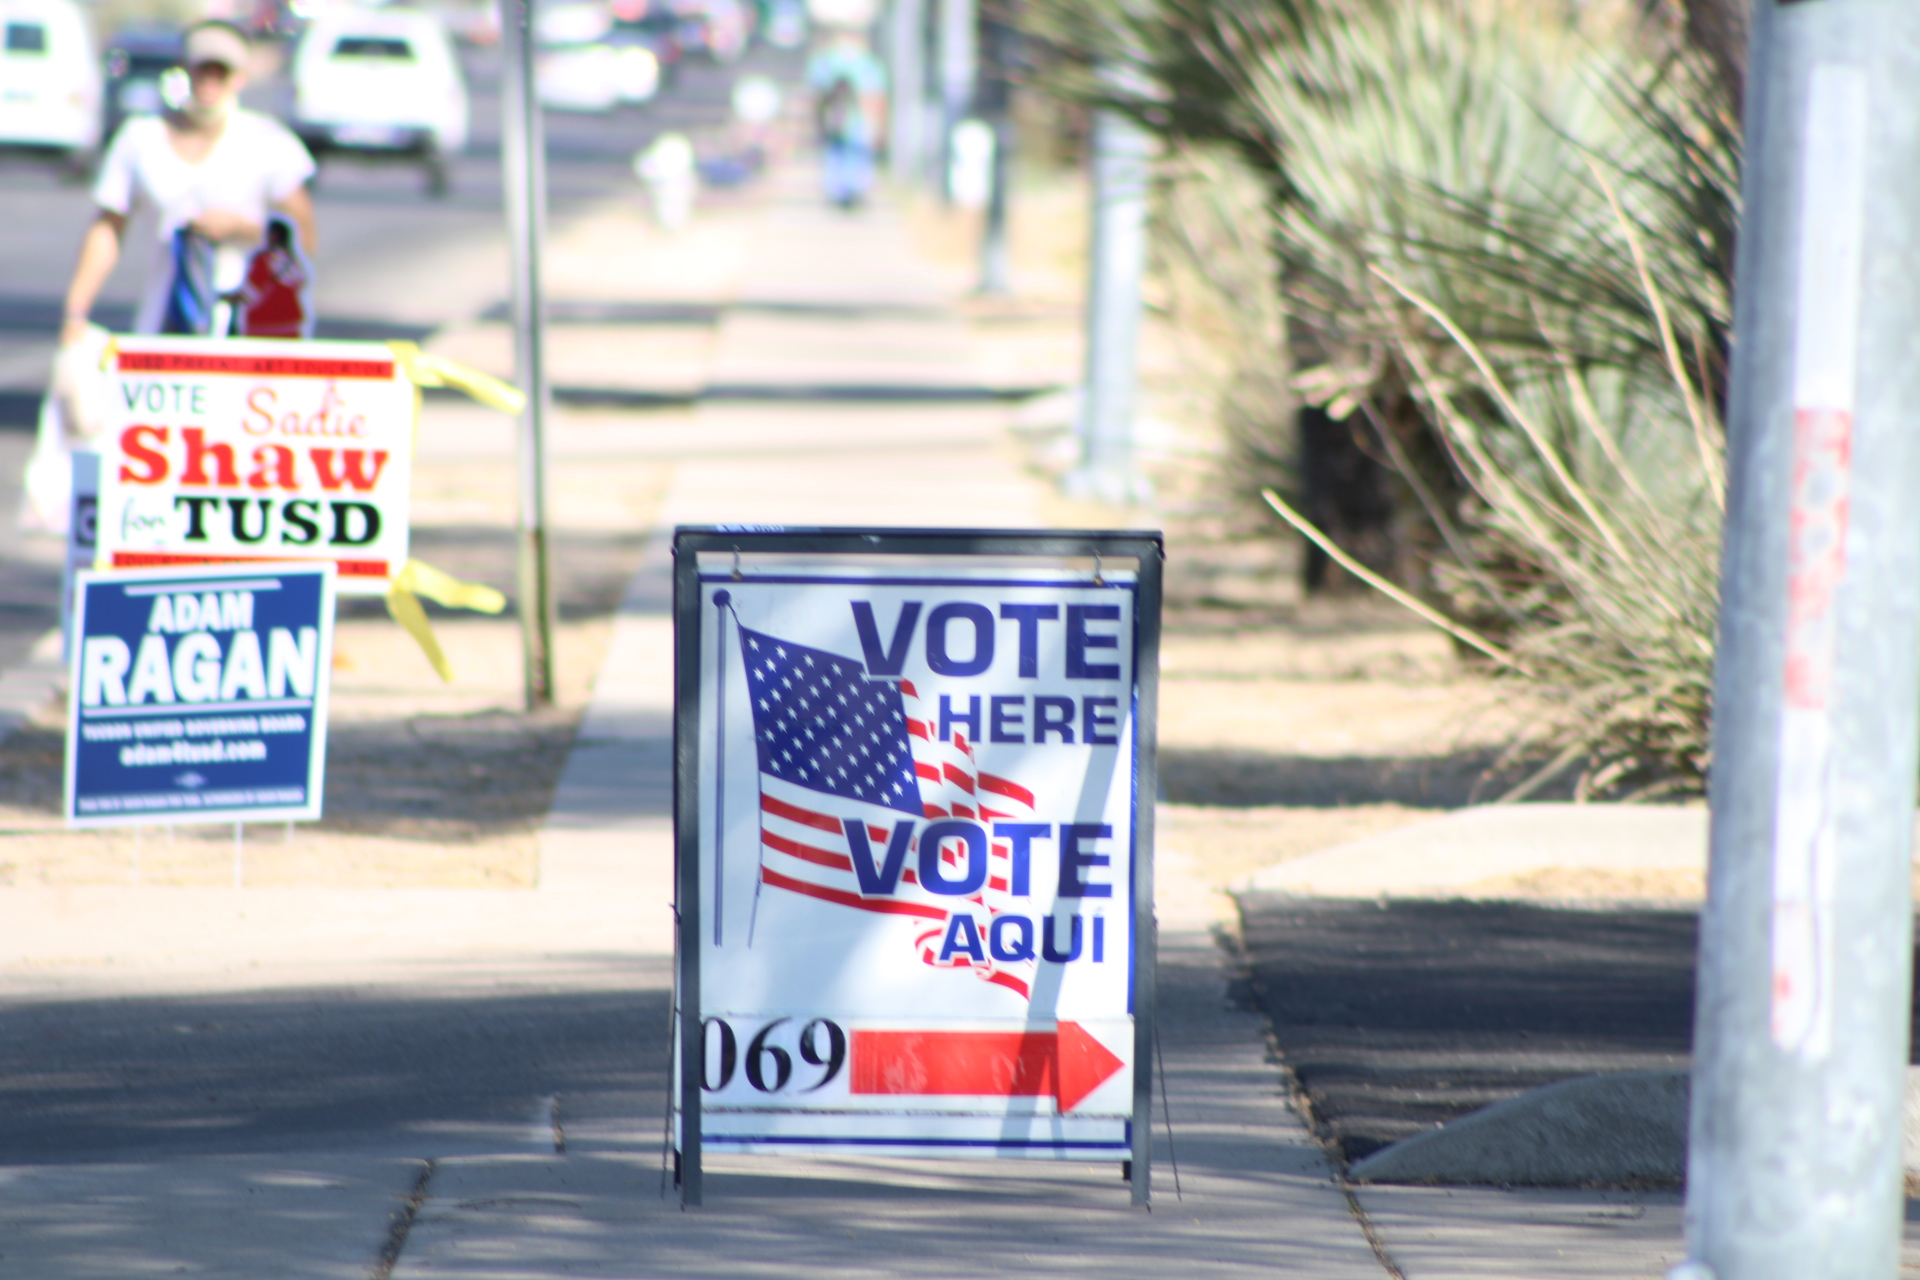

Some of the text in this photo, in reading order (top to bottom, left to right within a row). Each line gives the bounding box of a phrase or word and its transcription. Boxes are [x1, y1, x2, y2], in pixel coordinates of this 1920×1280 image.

[121, 378, 369, 438] VOTE Sadie
[118, 424, 388, 491] Shaw
[120, 496, 167, 543] for
[174, 495, 382, 546] TUSD
[150, 590, 254, 634] ADAM
[850, 600, 1121, 680] VOTE
[82, 625, 318, 707] RAGAN
[938, 694, 1119, 745] HERE
[842, 819, 1113, 898] VOTE
[700, 1016, 846, 1093] 069
